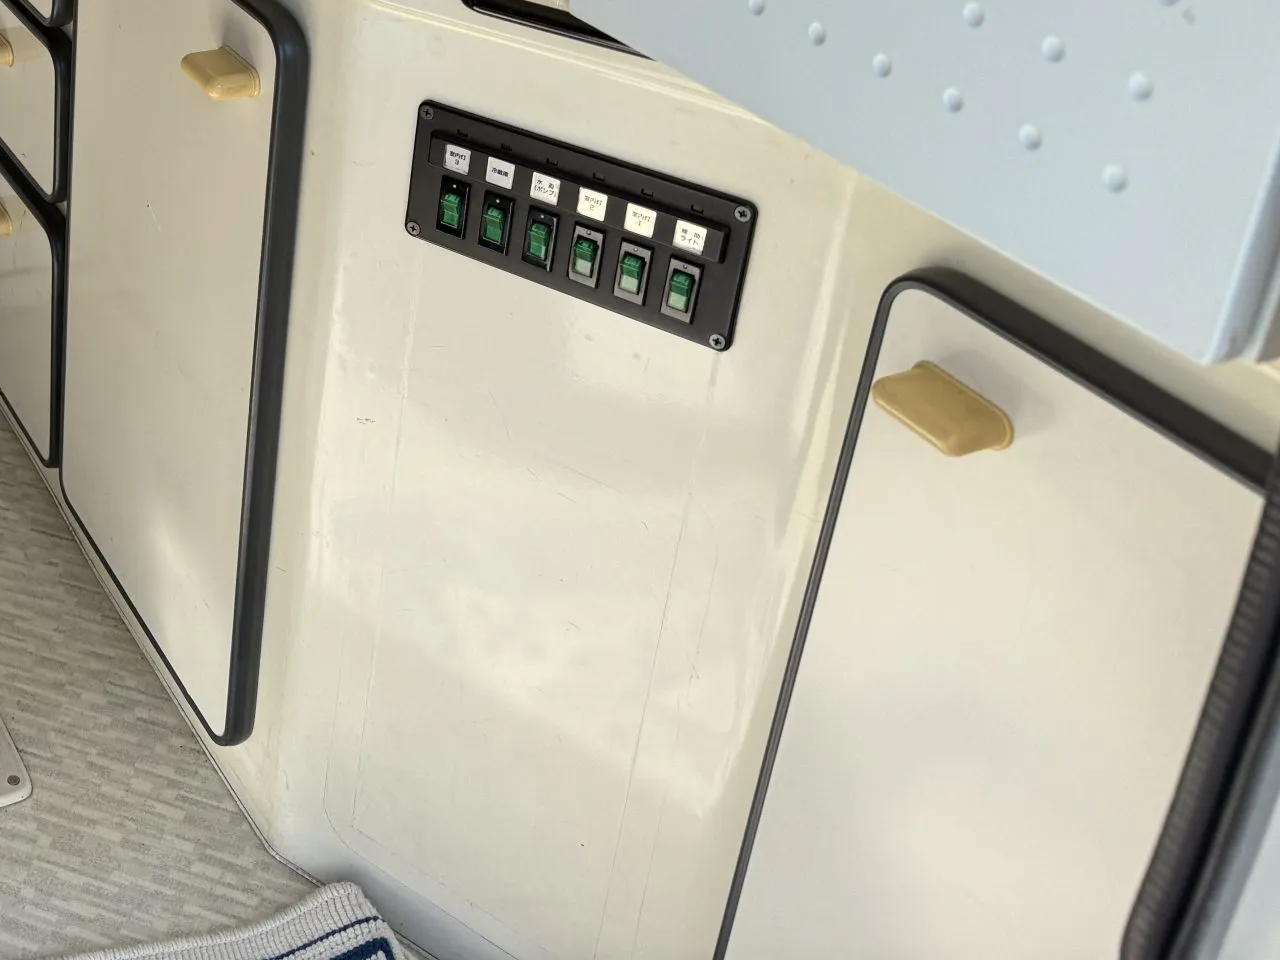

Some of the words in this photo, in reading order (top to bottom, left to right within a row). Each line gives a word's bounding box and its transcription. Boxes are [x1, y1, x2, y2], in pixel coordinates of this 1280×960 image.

[449, 150, 466, 161] 室内灯
[491, 167, 509, 177] 冷蔵庫
[584, 195, 603, 207] 室内灯
[632, 211, 651, 222] 室内灯
[680, 236, 699, 246] ライト
